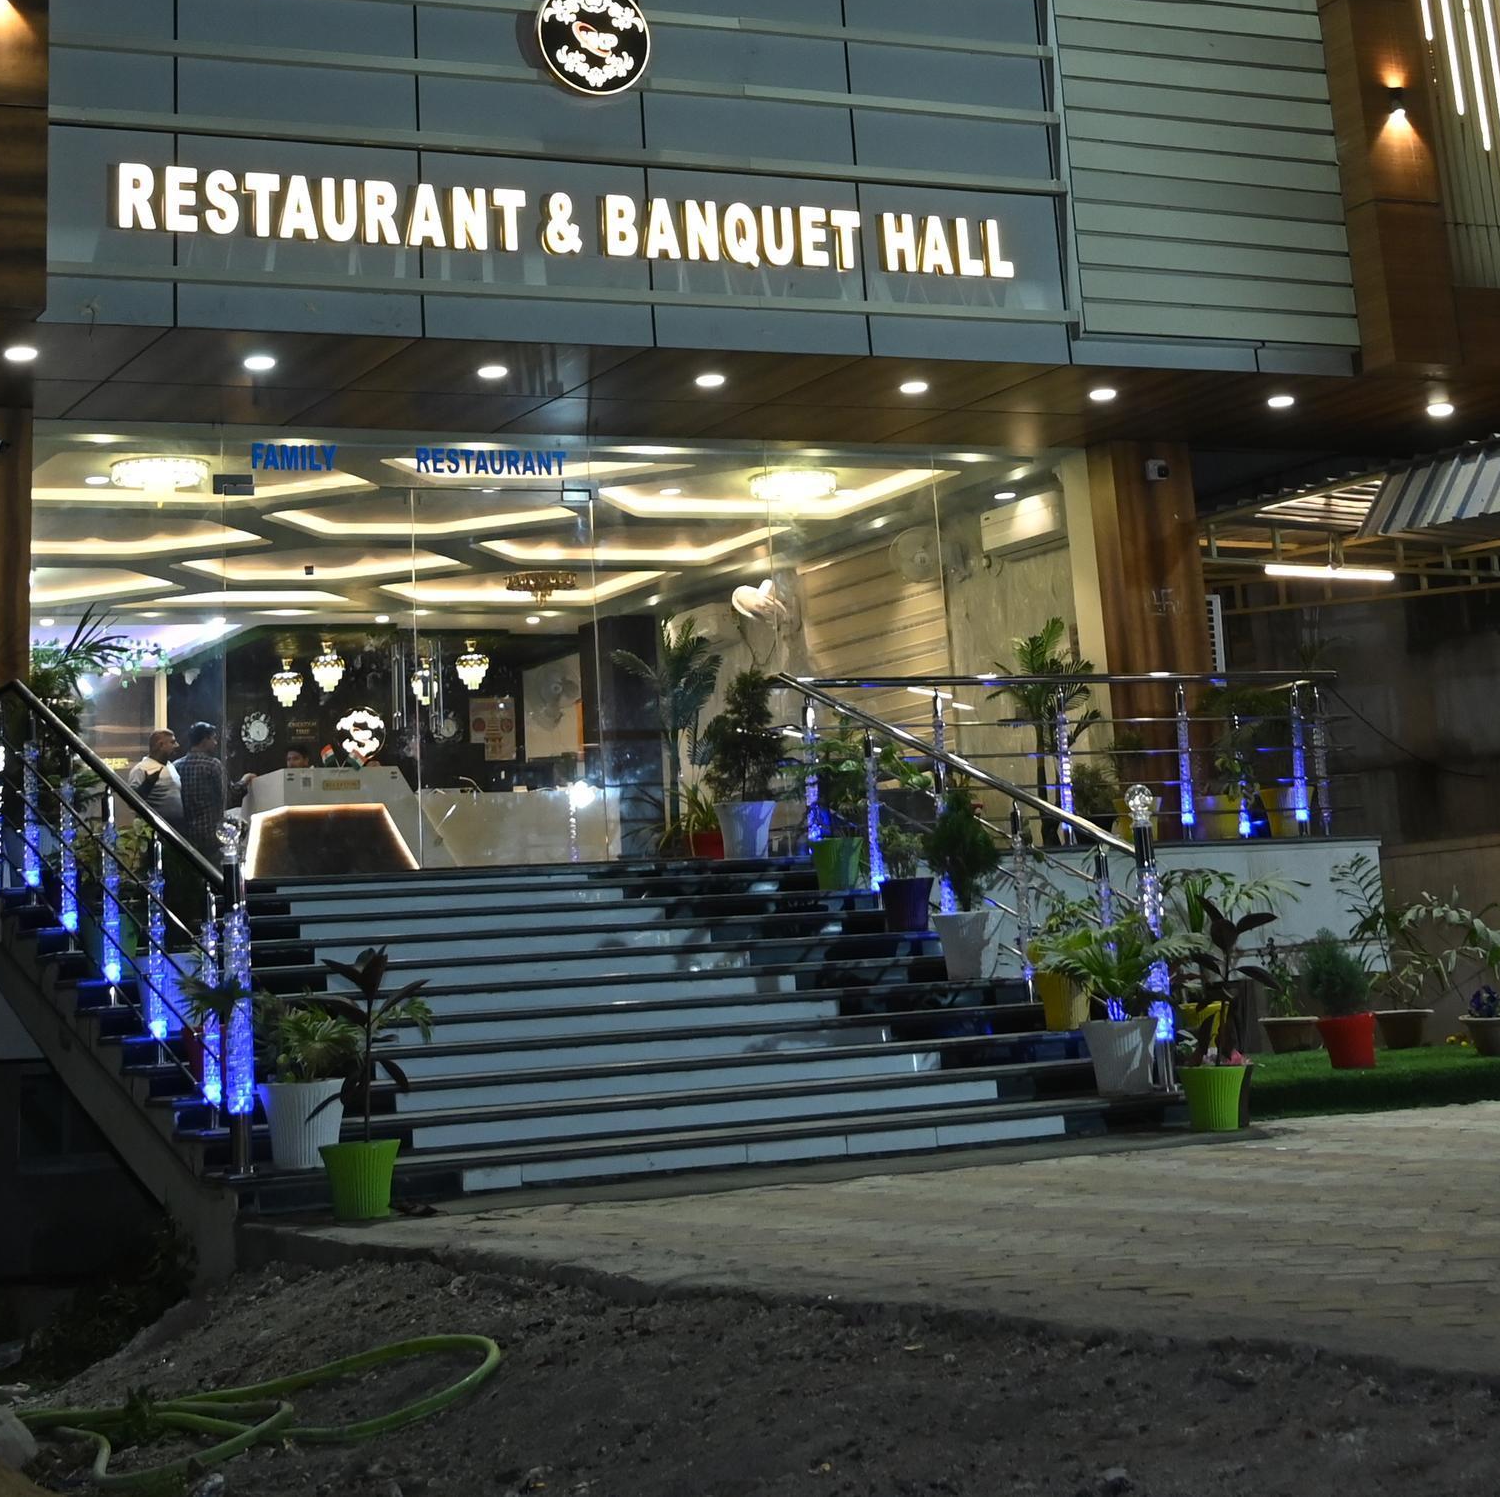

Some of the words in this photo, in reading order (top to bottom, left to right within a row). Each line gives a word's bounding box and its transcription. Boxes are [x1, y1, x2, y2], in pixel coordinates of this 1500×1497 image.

[118, 162, 527, 251] RESTAURANT
[543, 191, 583, 254] &
[602, 194, 861, 271] BANQUET
[881, 212, 1015, 278] HALL
[252, 442, 337, 472] FAMILY
[415, 446, 567, 476] RESTAURANT
